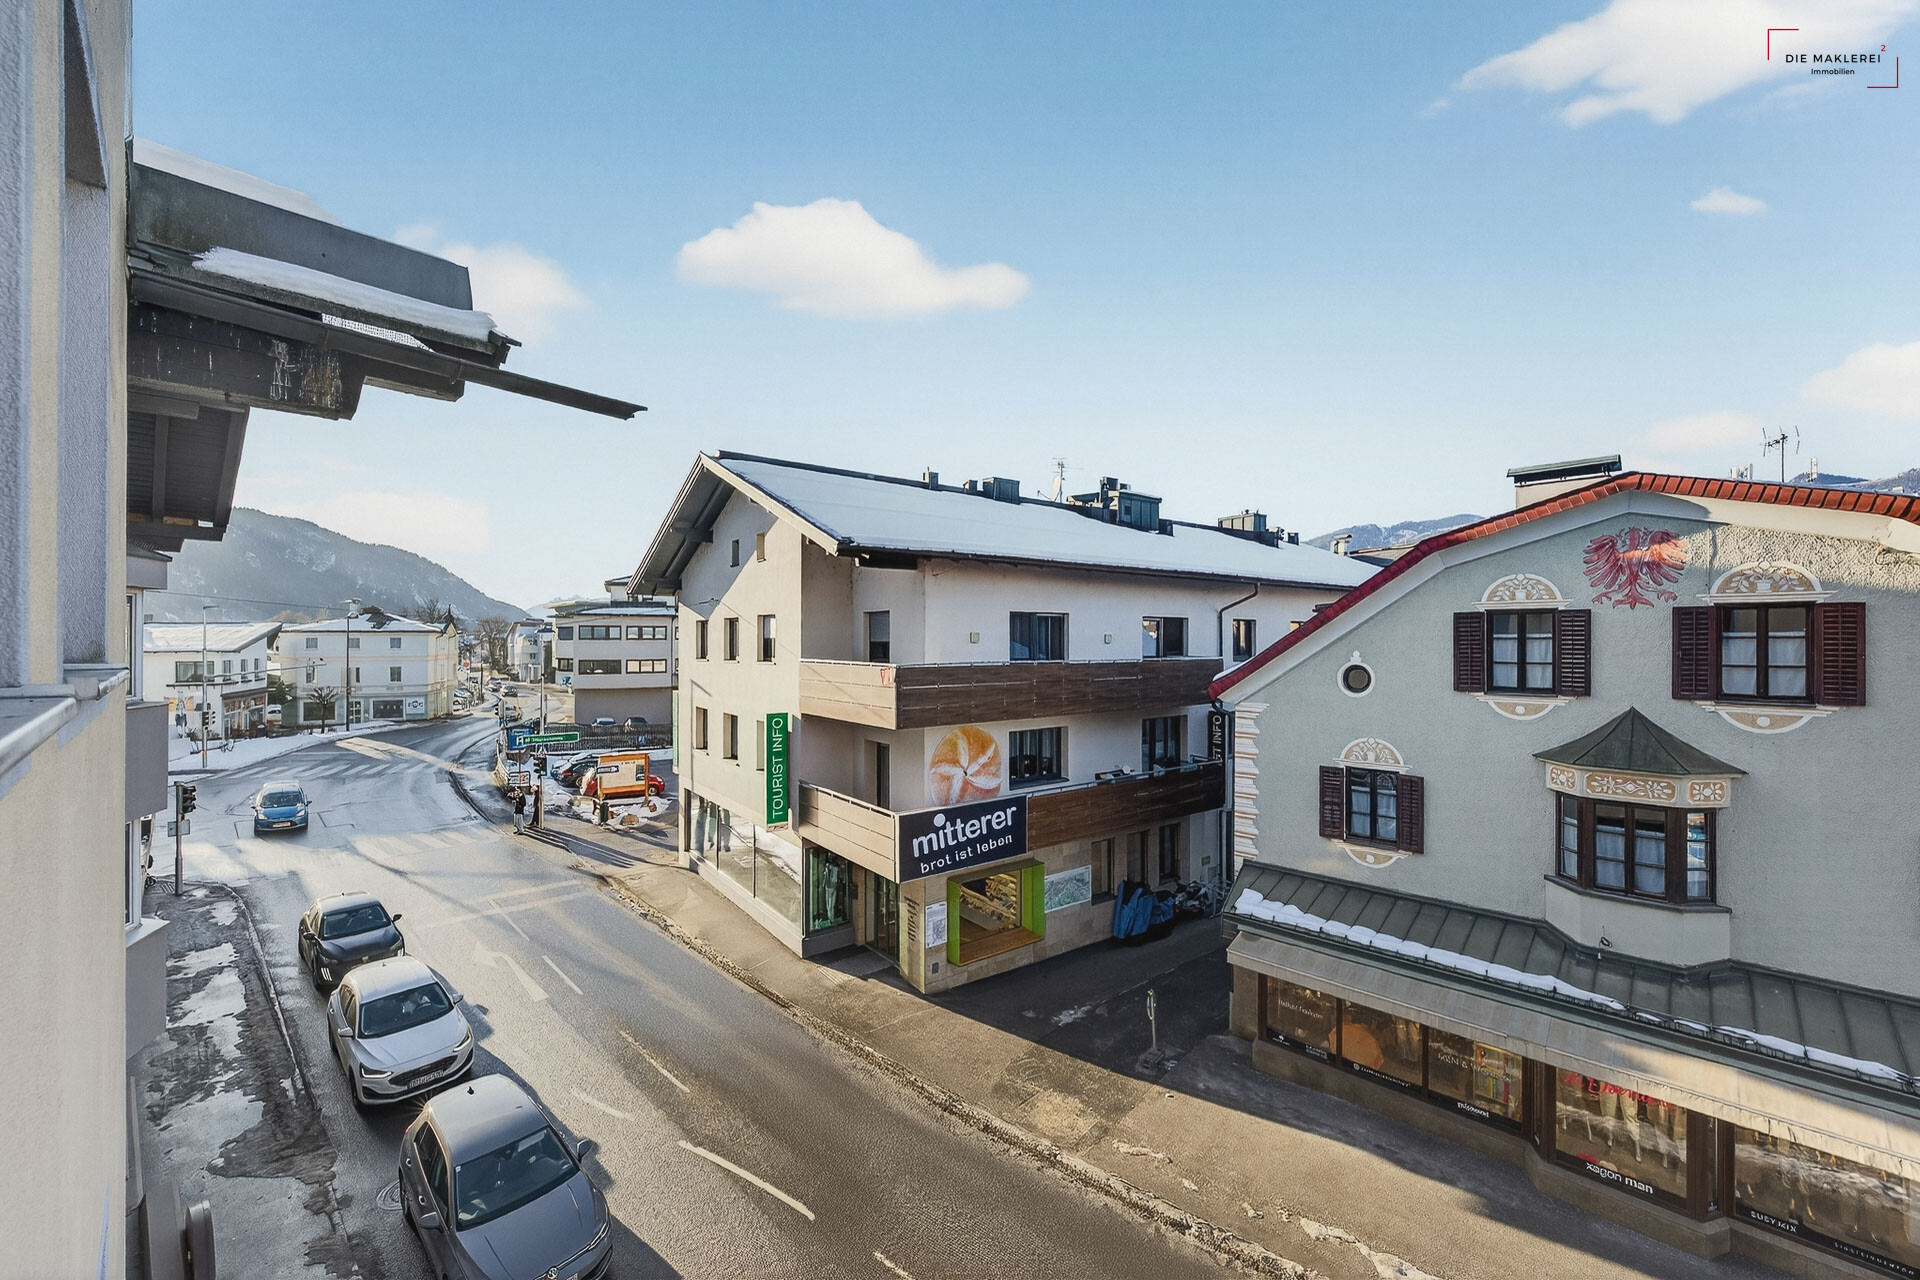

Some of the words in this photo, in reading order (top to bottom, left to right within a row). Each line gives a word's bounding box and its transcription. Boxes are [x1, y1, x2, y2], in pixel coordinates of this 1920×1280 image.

[772, 717, 784, 752] INFO
[1212, 715, 1222, 744] INFO
[772, 755, 784, 819] TOURIST
[912, 806, 1017, 858] mitterer
[920, 854, 952, 874] brot
[955, 846, 974, 862] ist
[976, 835, 1013, 855] leben
[1586, 1161, 1622, 1182] xagon
[1625, 1177, 1654, 1194] man
